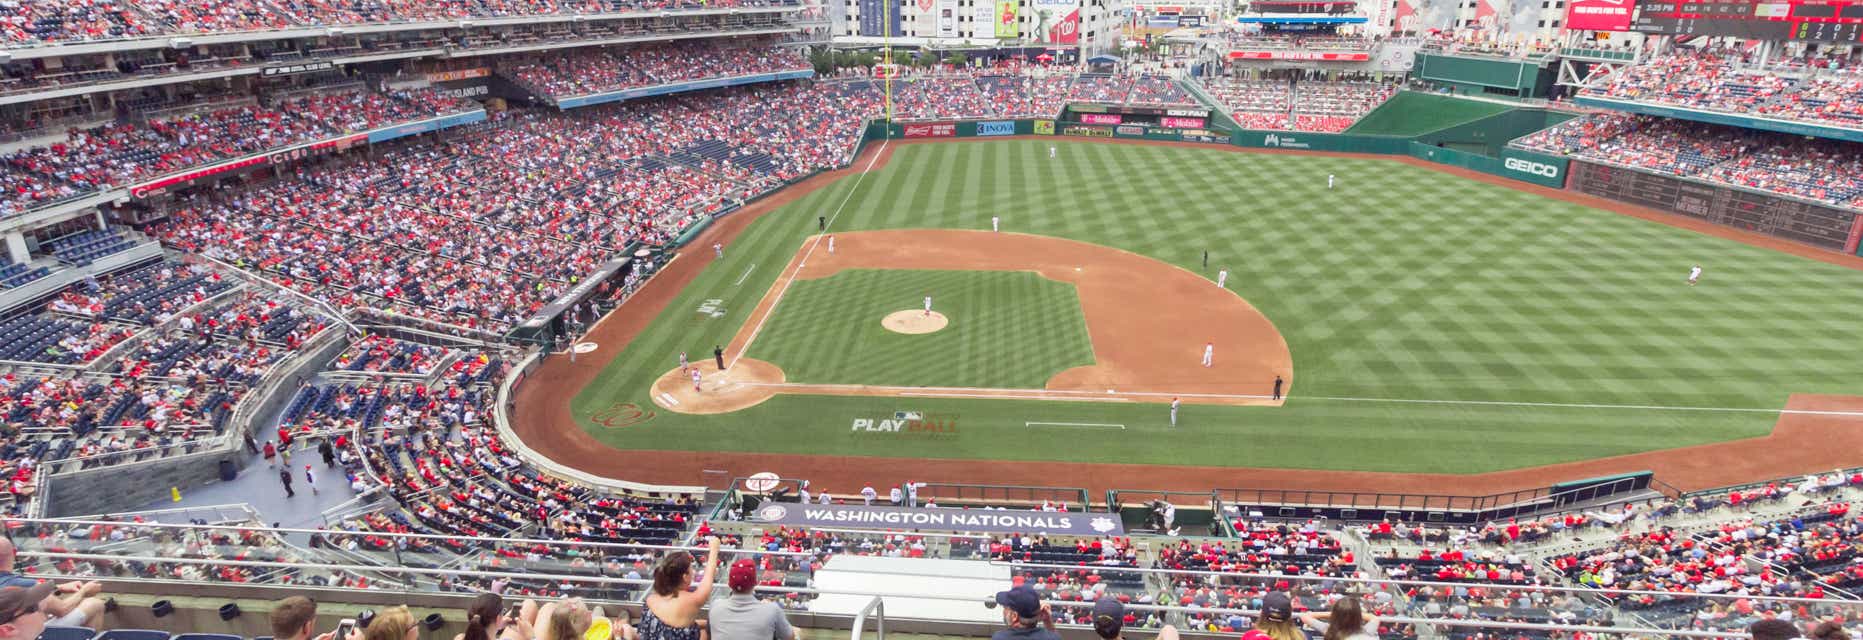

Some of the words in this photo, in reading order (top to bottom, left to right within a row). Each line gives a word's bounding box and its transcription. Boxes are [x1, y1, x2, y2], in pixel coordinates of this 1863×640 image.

[1818, 23, 1825, 31] 7
[1814, 31, 1822, 40] 2
[1848, 32, 1856, 40] 3
[986, 122, 1014, 133] INOVA
[1504, 157, 1558, 178] GEICO
[851, 418, 904, 432] PLAY
[804, 509, 944, 526] WASHINGTON
[952, 513, 1072, 529] NATIONALS
